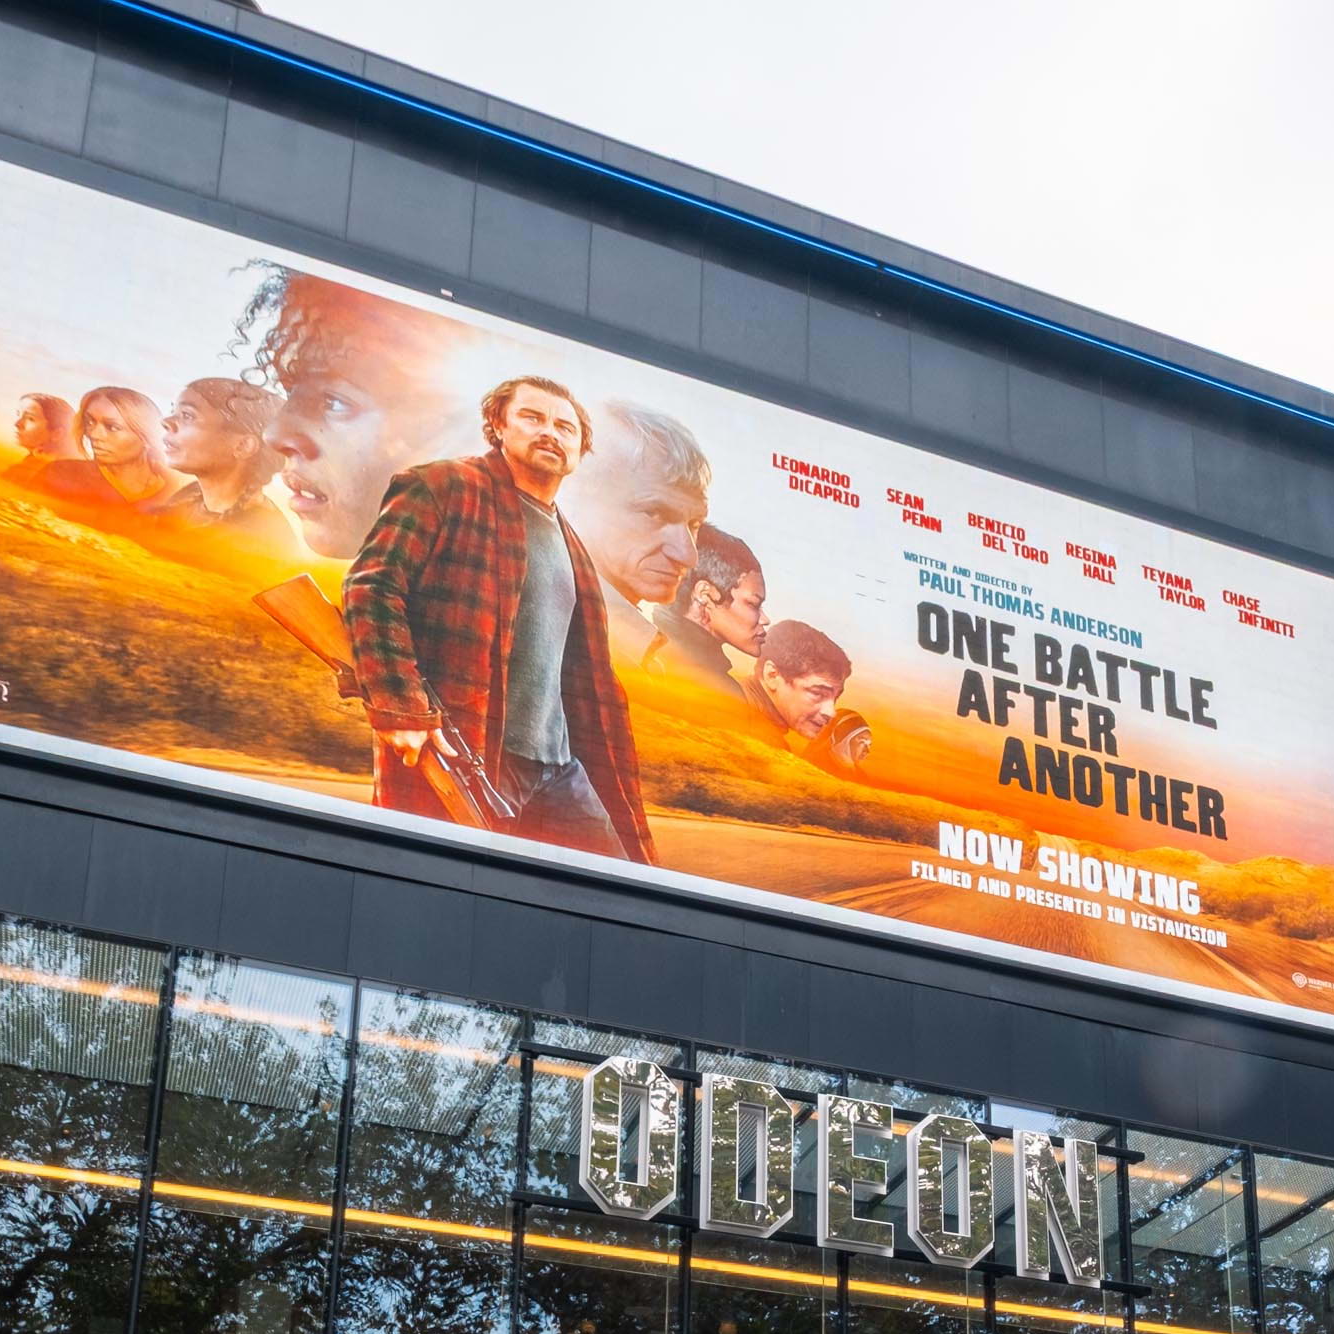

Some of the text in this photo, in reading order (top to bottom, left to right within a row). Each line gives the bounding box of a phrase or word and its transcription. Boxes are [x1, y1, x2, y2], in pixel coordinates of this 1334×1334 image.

[772, 453, 851, 489] LEONARDO
[887, 488, 924, 511] SEAN
[903, 509, 942, 533] PENN
[967, 512, 1026, 542] BENICIO
[982, 533, 1049, 565] DEL TORO
[1066, 541, 1117, 570] REGINA
[903, 551, 1033, 597] WRITTEN AND DIRECTED BY
[1083, 563, 1115, 585] HALL
[1141, 565, 1193, 592] TEYANA
[919, 569, 1143, 649] PAUL THOMAS ANDERSON
[1157, 585, 1206, 612] TAYLOR
[1222, 589, 1261, 613] CHASE
[1238, 609, 1296, 639] INFINITI
[917, 600, 1217, 730] ONE BATTLE
[957, 668, 1119, 758] AFTER
[998, 736, 1228, 841] ANOTHER
[938, 821, 1201, 916] NOW SHOWING
[911, 860, 1228, 948] FILMED AND PRESENTED IN VISTAVISION
[578, 1055, 1103, 1289] ODEON
